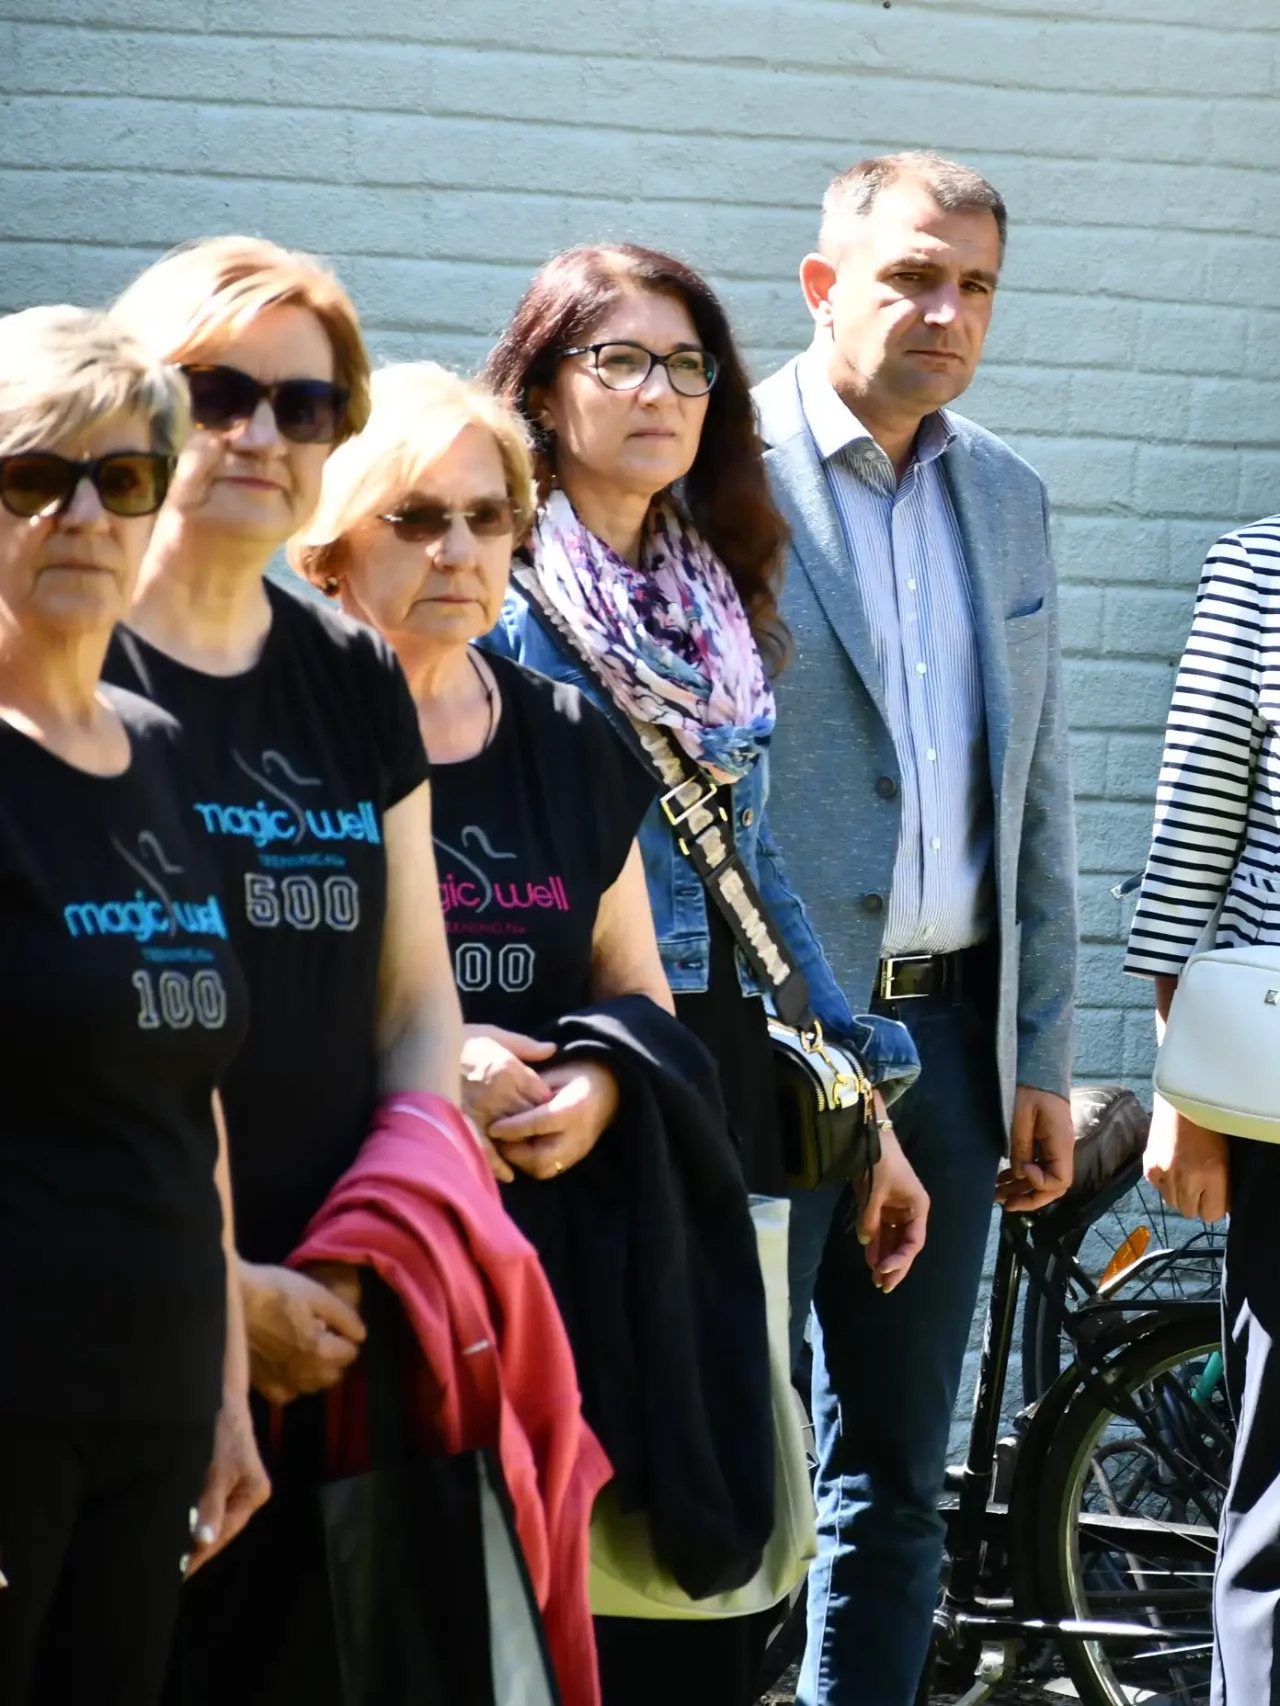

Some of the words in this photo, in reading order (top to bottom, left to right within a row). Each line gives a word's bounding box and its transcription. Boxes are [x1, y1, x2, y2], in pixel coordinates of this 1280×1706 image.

[304, 800, 381, 845] well
[244, 872, 360, 932] 500
[493, 875, 571, 912] well
[454, 942, 536, 993] 00
[131, 968, 228, 1031] 100
